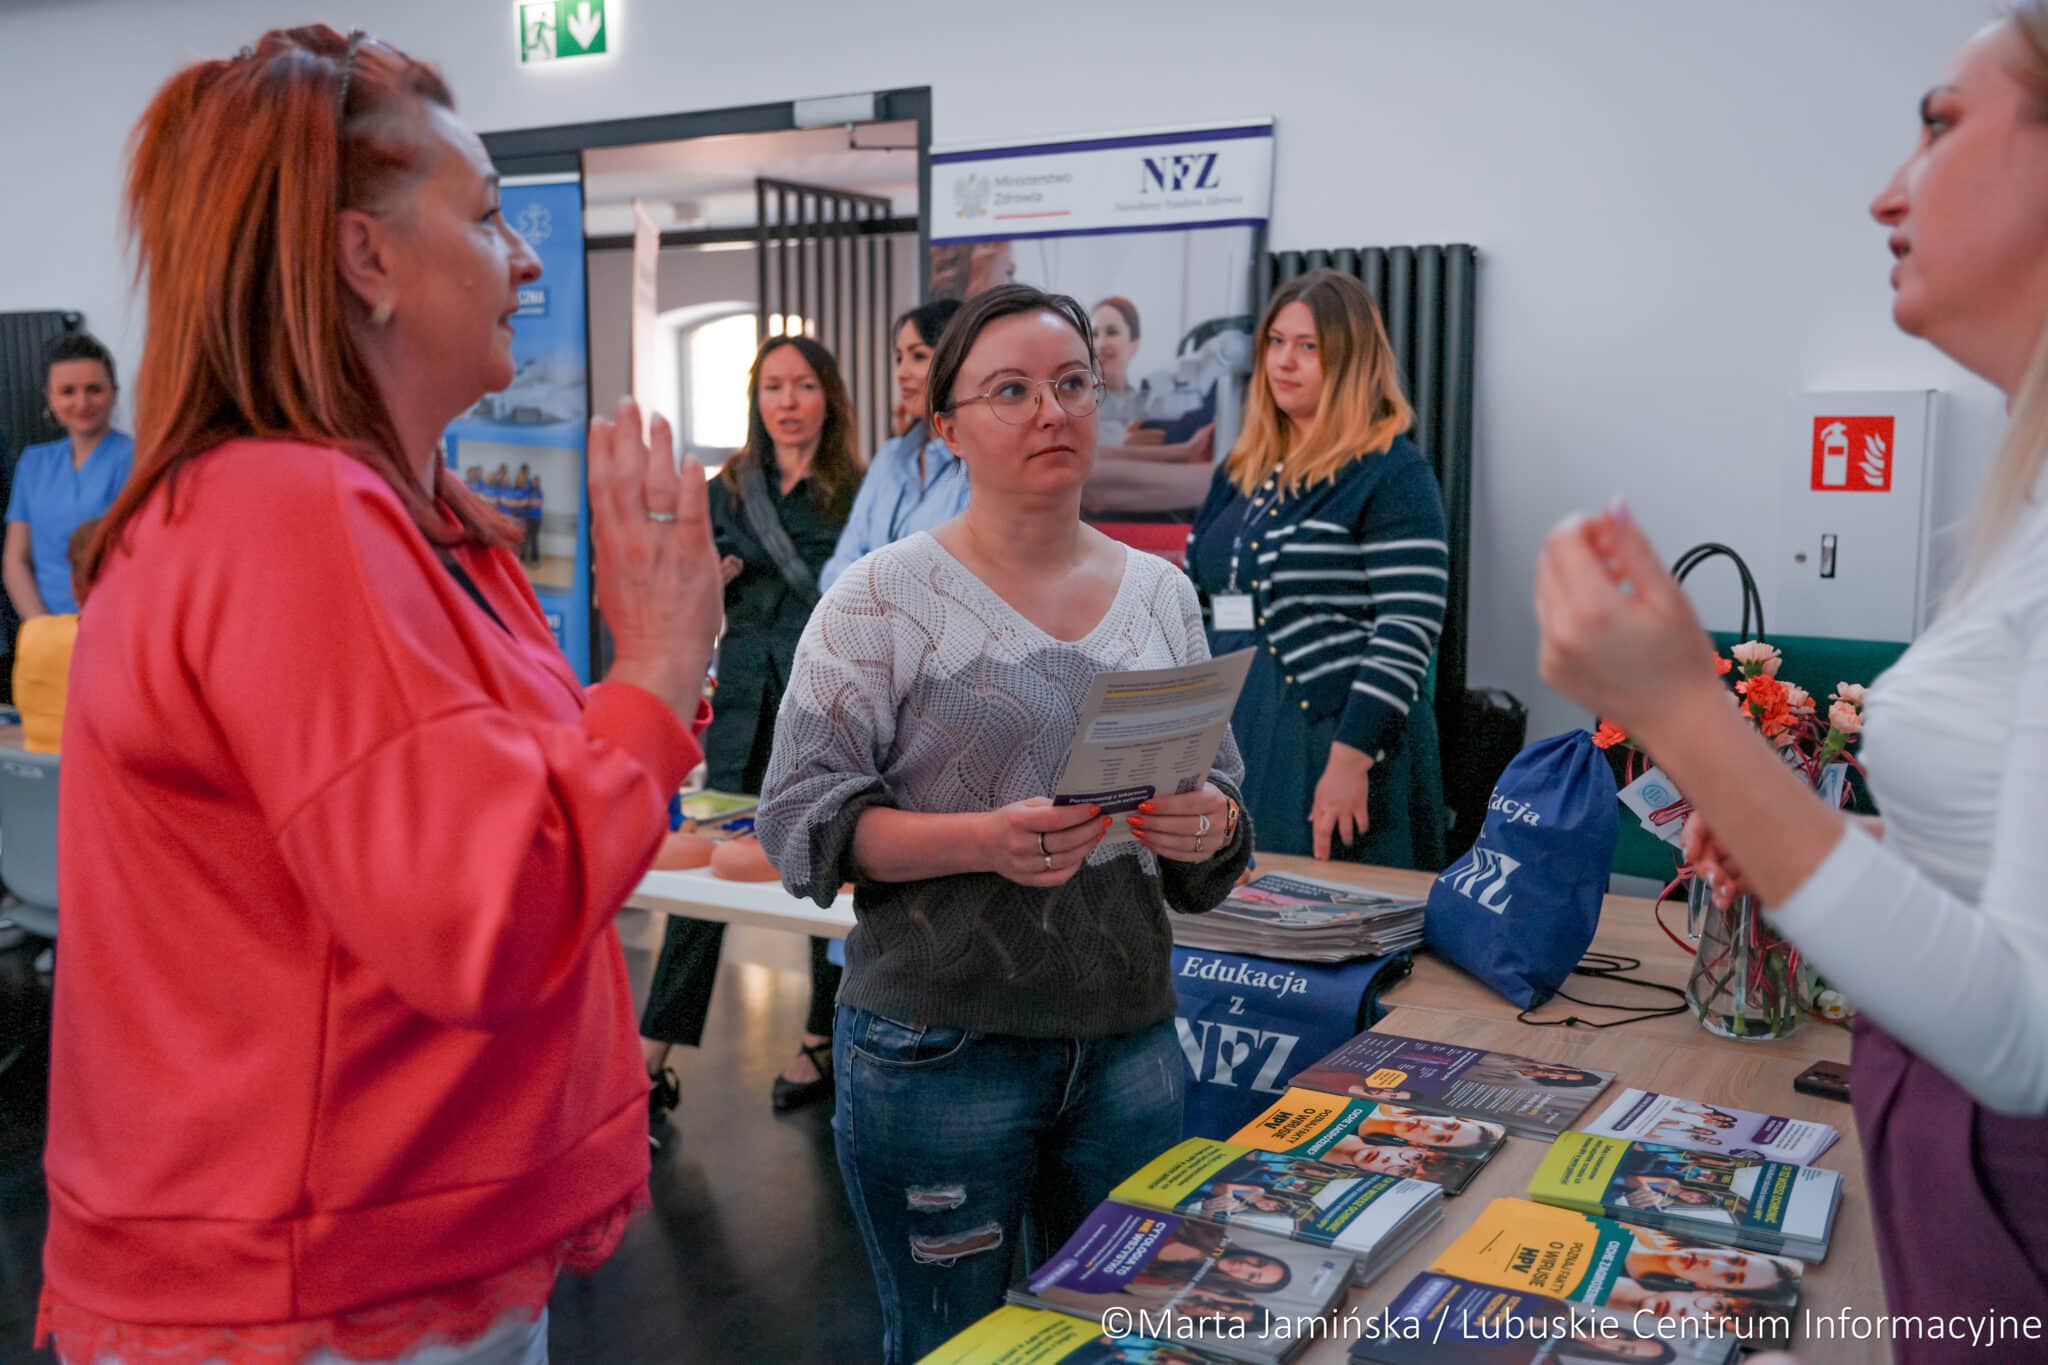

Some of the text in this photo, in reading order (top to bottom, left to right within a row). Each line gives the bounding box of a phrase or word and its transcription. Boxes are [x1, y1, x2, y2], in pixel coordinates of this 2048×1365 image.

[1141, 153, 1220, 194] NFZ
[1179, 956, 1308, 998] Edukacja
[1229, 996, 1246, 1015] z
[1174, 1015, 1300, 1095] NFZ
[1264, 1111, 1294, 1130] HPV
[1128, 1221, 1167, 1266] CYTOLOGIA
[1512, 1246, 1540, 1274] HPV
[1529, 1241, 1564, 1288] O WIRUSIE
[1552, 1241, 1584, 1294] POZNAJ FAKTY
